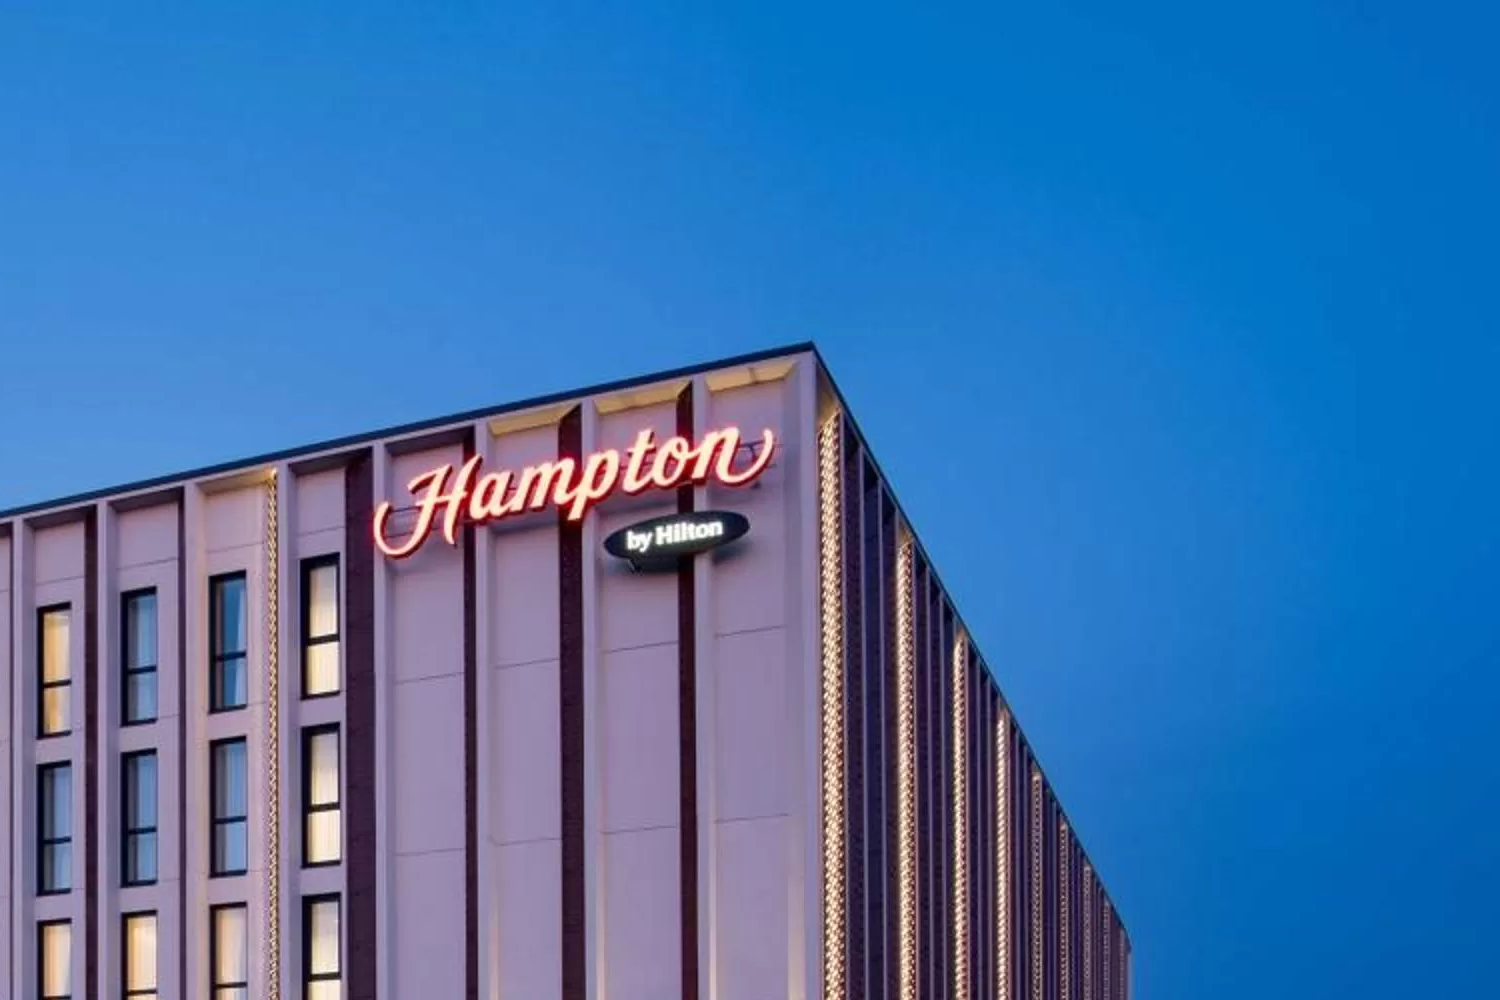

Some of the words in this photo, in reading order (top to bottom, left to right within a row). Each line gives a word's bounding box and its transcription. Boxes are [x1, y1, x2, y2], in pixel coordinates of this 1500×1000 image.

[373, 426, 776, 556] Hampton
[626, 529, 653, 553] by
[655, 521, 724, 545] Hilton
